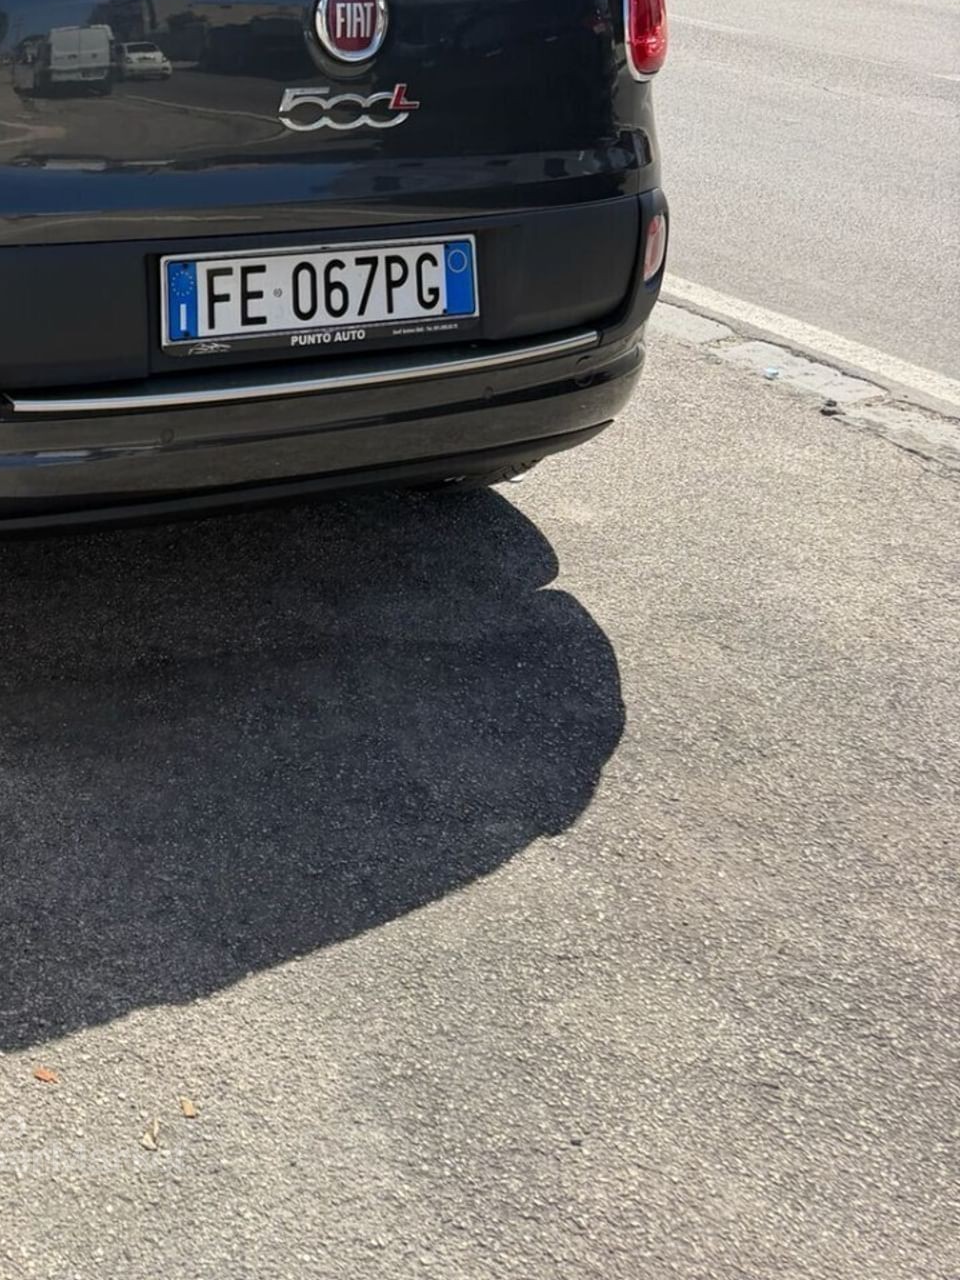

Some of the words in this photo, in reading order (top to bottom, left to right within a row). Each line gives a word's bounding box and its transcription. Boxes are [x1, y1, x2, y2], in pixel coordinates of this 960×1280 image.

[335, 2, 375, 38] FIAT
[278, 83, 420, 131] 500L
[205, 264, 268, 330] FE
[291, 252, 441, 321] 067PG
[290, 333, 332, 347] PUNTO
[334, 329, 366, 343] AUTO
